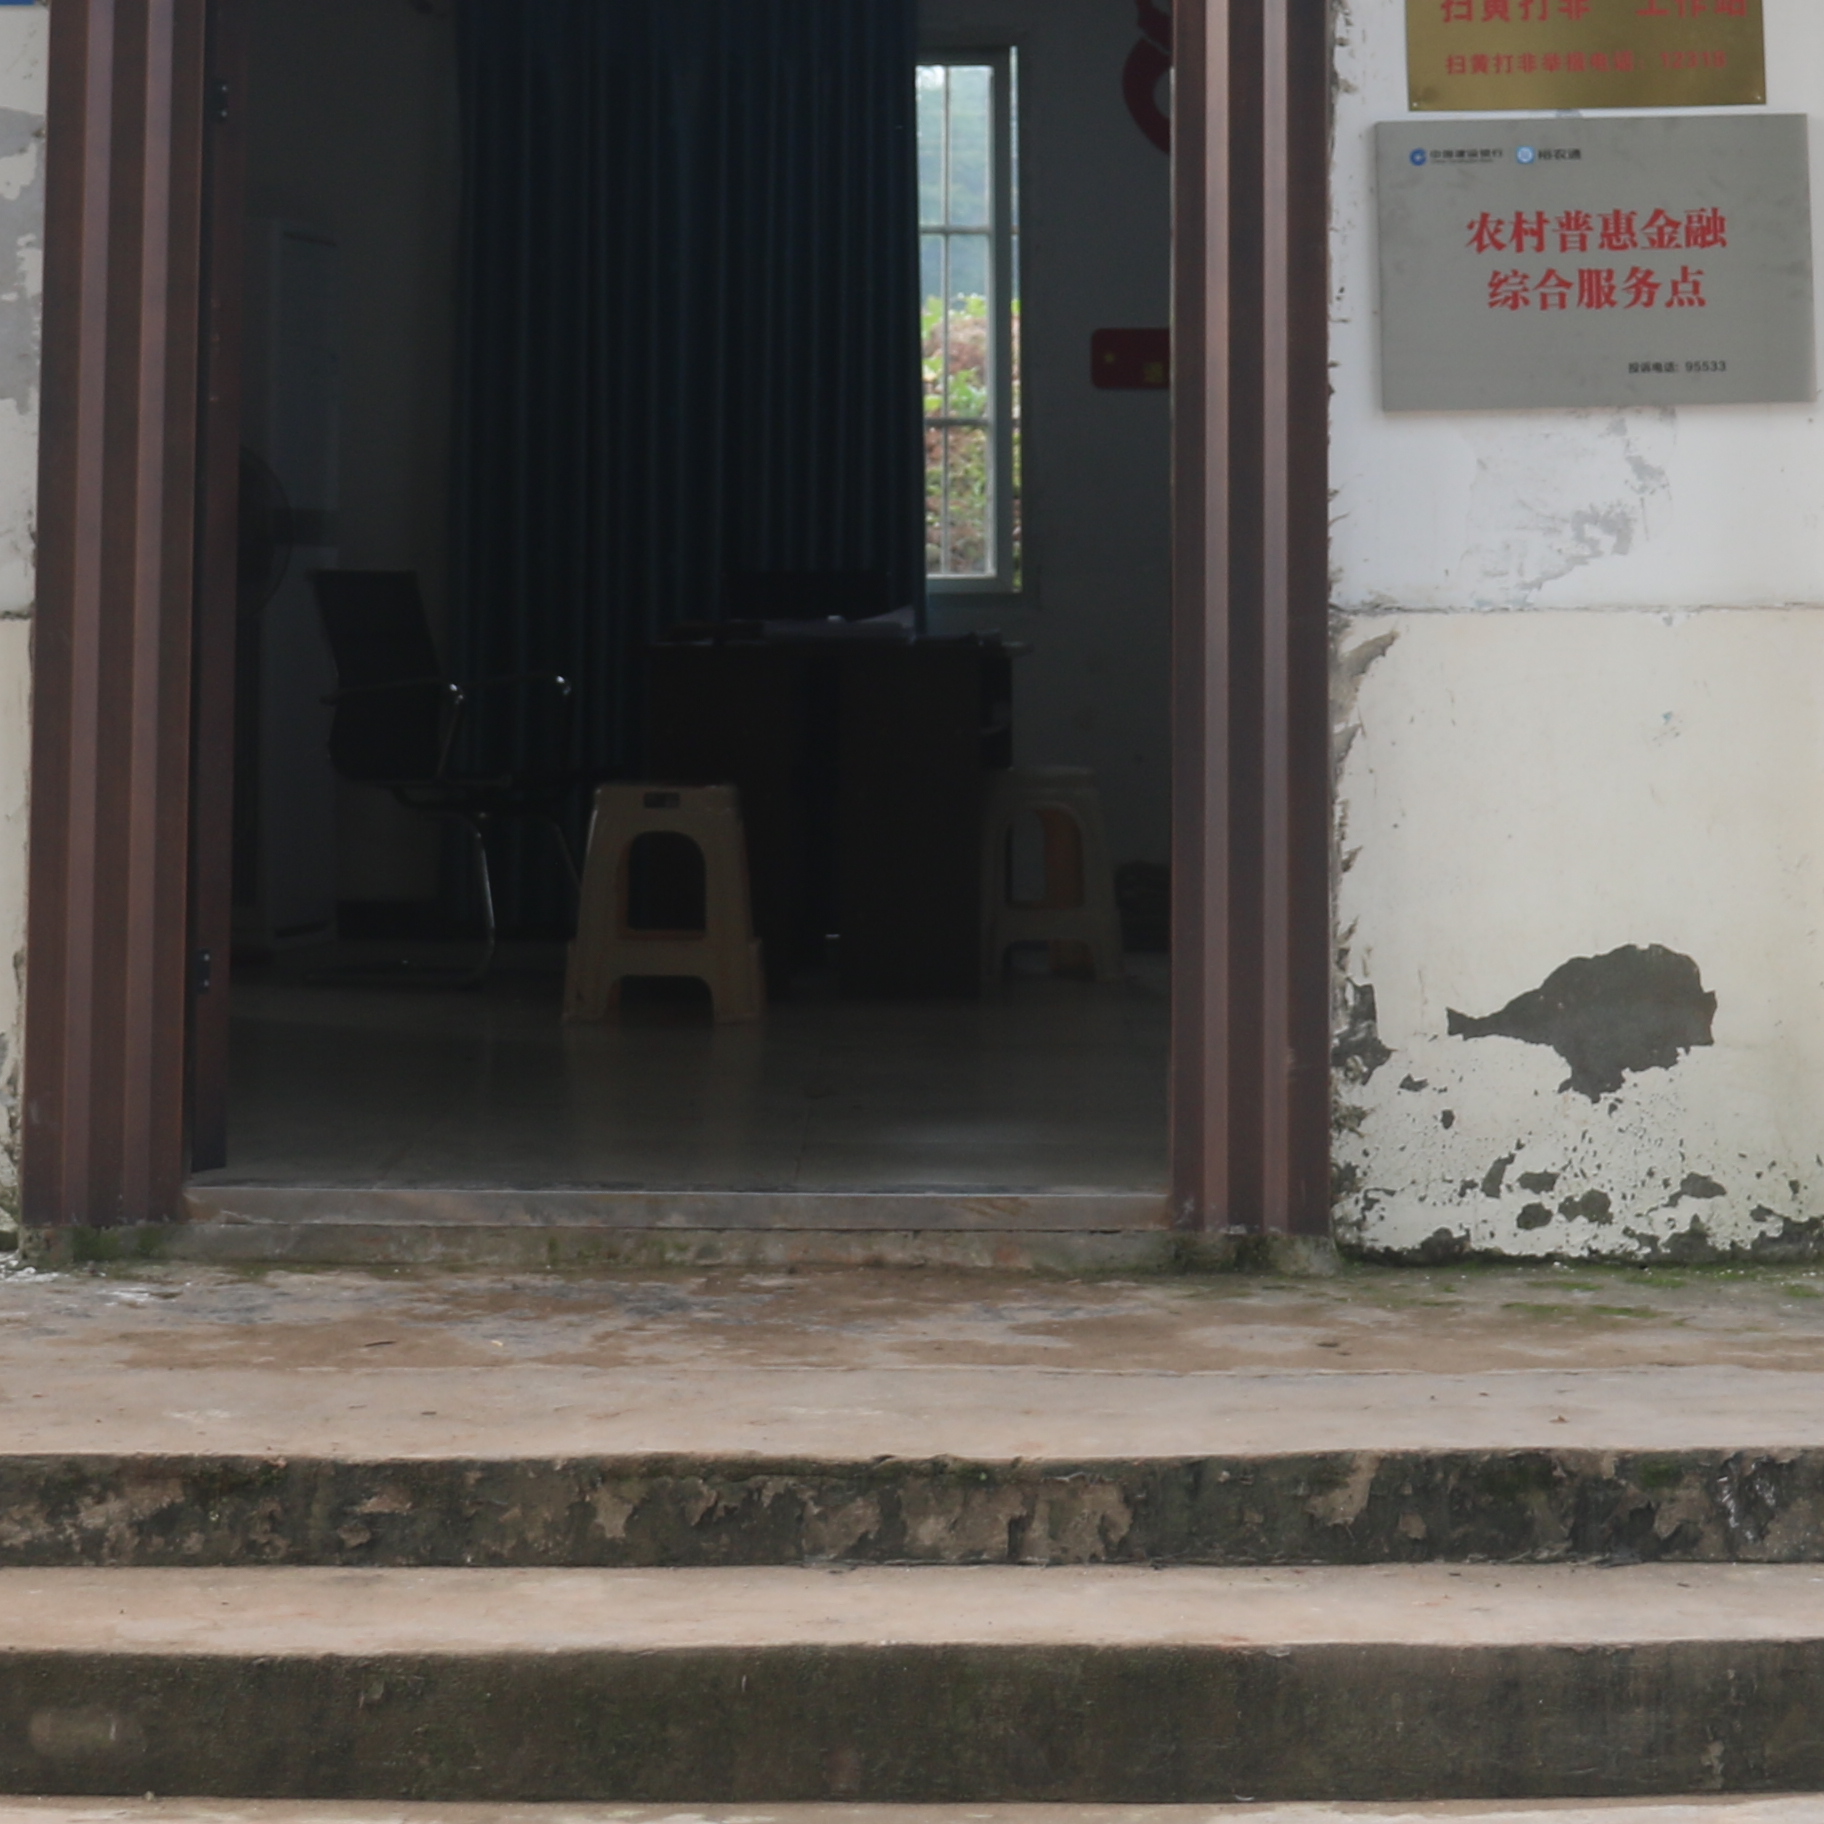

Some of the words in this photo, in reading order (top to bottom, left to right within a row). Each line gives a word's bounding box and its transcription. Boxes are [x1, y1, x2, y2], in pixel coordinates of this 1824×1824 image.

[1464, 207, 1729, 255] 农村普惠金融
[1487, 265, 1707, 311] 综合服务点
